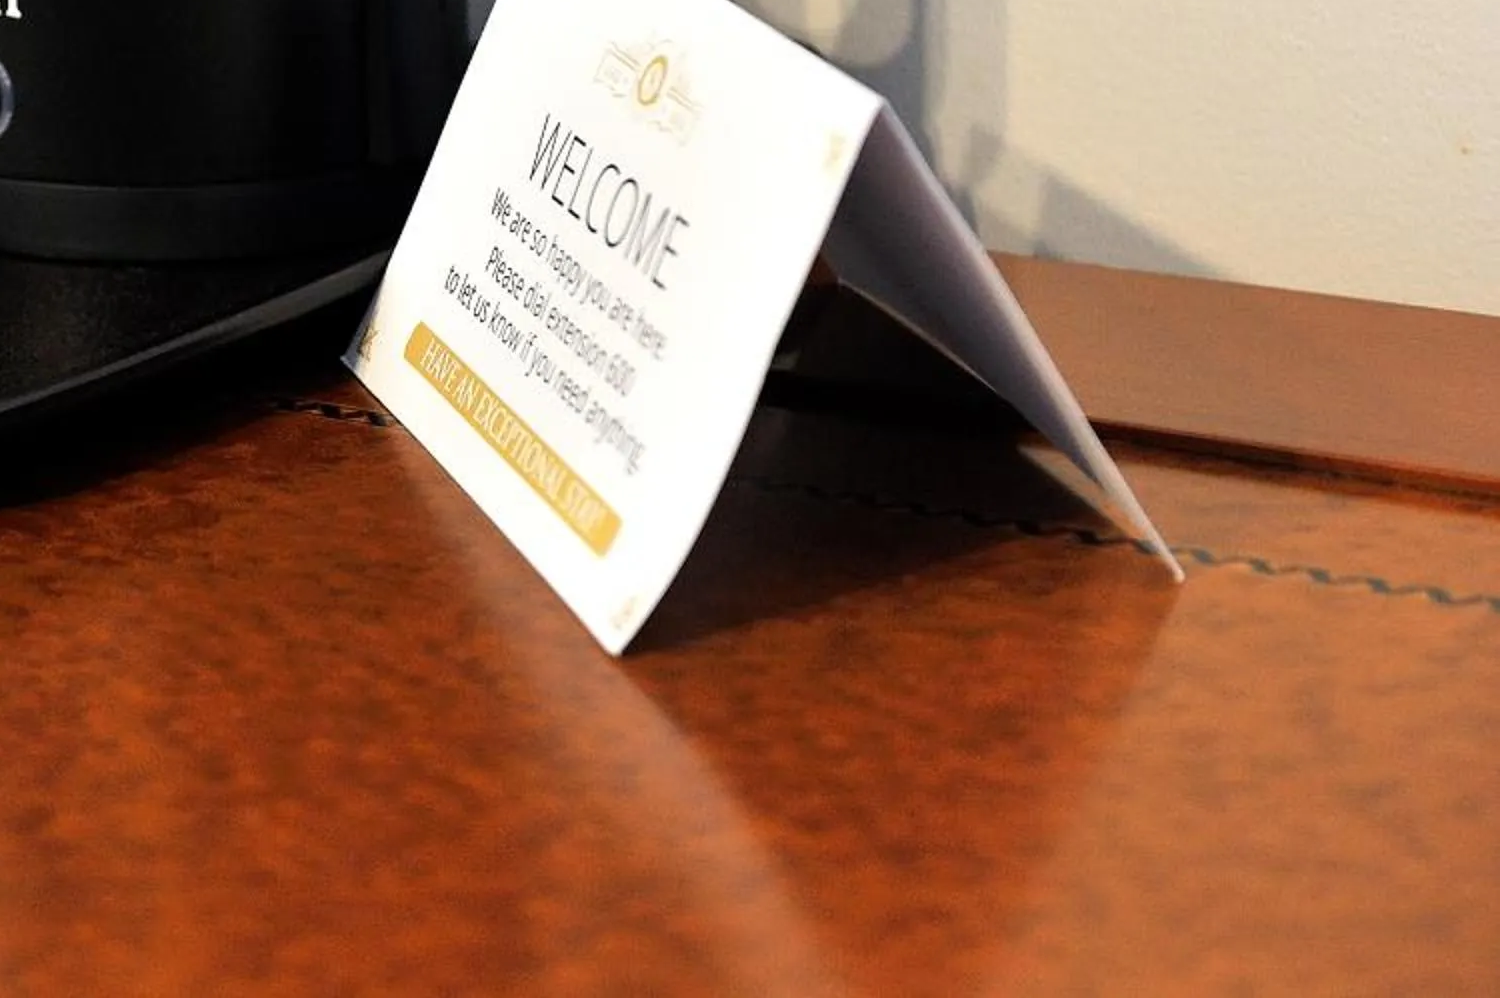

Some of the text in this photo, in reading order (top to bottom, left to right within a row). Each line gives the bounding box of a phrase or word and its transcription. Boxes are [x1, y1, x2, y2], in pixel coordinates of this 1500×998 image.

[529, 113, 690, 290] WELCOME
[444, 266, 461, 295] to
[491, 187, 512, 226] We
[509, 211, 533, 244] are
[529, 229, 548, 257] so
[546, 234, 589, 297] happy
[579, 270, 611, 312] you
[608, 297, 634, 332] are
[457, 273, 478, 311] let
[473, 295, 492, 324] us
[486, 246, 525, 301] Please
[523, 281, 551, 321] dial
[546, 306, 608, 369] extension
[488, 302, 526, 354] know
[519, 332, 538, 362] if
[525, 345, 557, 385] you
[550, 369, 592, 415] need
[419, 337, 459, 393] HAVE
[455, 376, 480, 412] AN
[473, 393, 567, 501] EXCEPTIONAL
